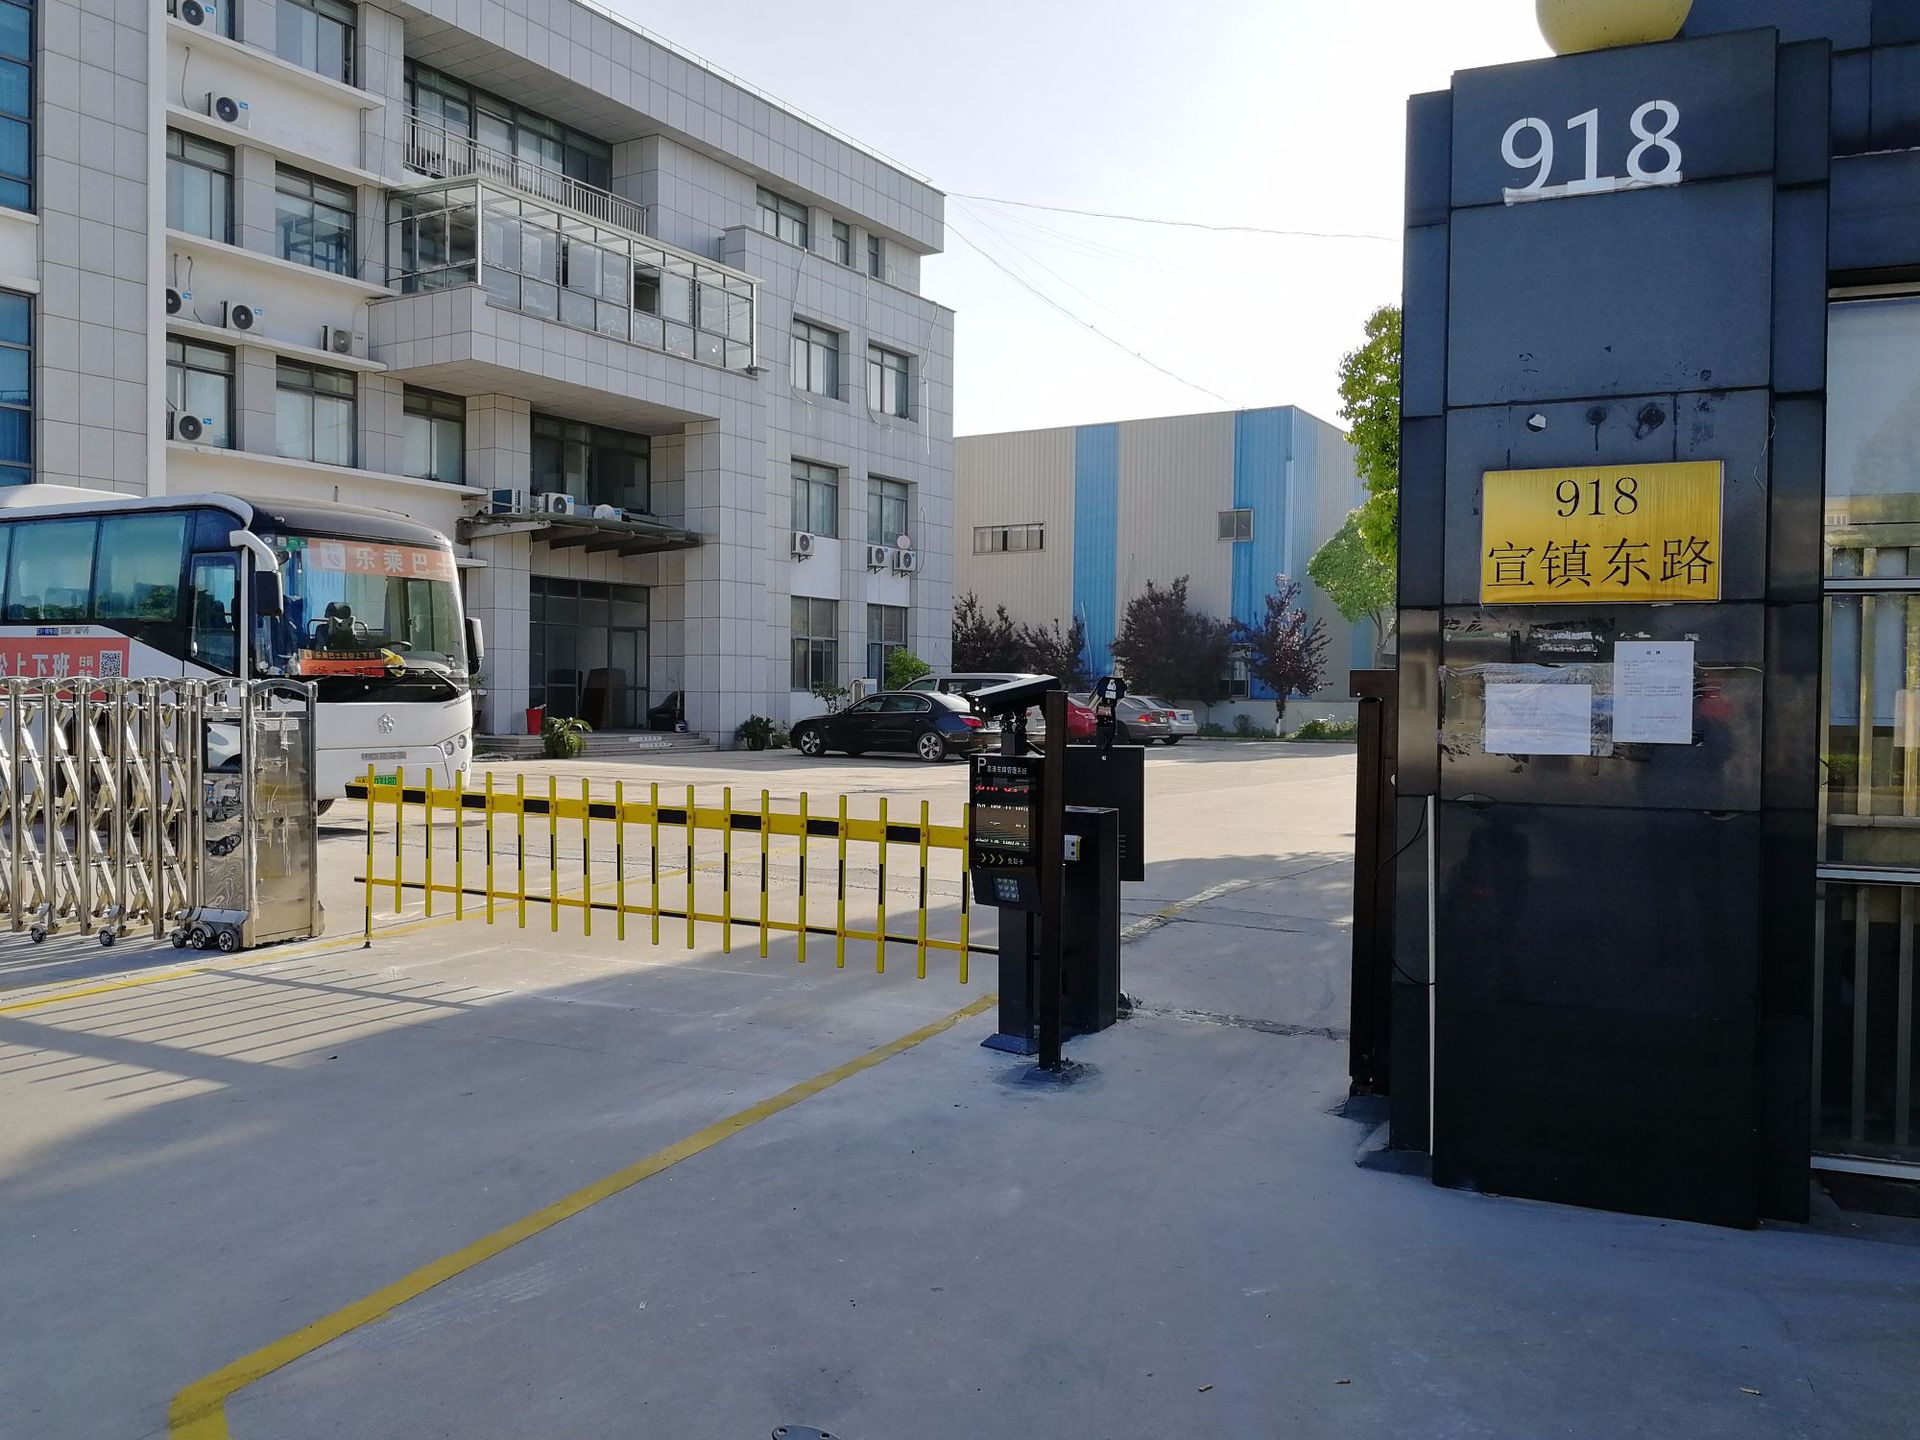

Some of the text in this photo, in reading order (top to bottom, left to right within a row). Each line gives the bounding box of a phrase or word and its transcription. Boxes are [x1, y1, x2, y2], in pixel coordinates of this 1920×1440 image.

[1501, 99, 1683, 199] 918
[1555, 477, 1639, 517] 918
[355, 547, 452, 577] 乐乘巴士
[1486, 536, 1715, 589] 宣镇东路
